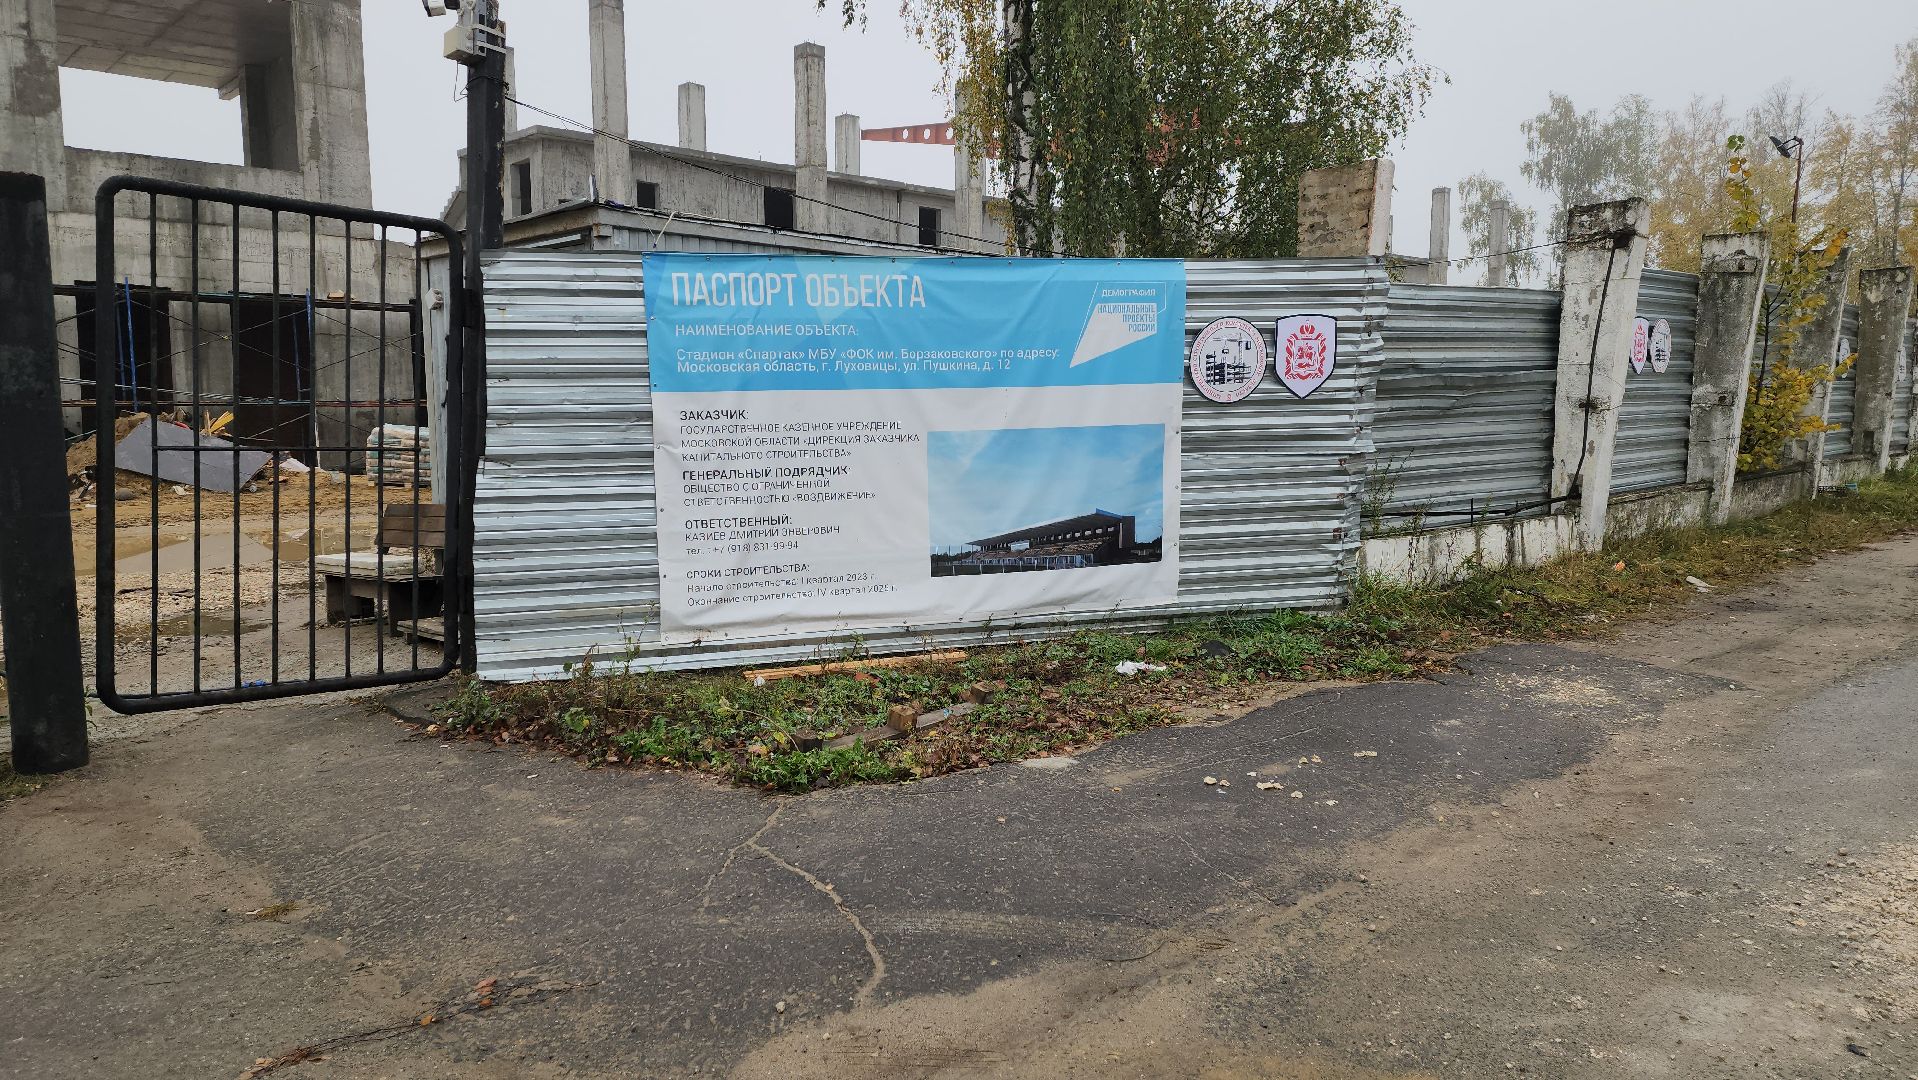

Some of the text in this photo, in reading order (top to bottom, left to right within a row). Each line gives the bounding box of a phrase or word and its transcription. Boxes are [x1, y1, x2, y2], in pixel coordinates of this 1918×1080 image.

[671, 272, 926, 308] ПАСПОРТ ОБЪЕКТА
[1101, 288, 1156, 298] ДЕМОГРАФИЯ
[1097, 303, 1156, 315] НАЦИОНАЛЬНЫЕ
[1122, 314, 1156, 323] ПРОЕКТЫ
[675, 324, 859, 337] НАИМЕНОВАНИЕ ОБЪЕКТА:
[1128, 323, 1156, 333] РОССИИ
[677, 348, 1060, 362] Стадион «Спартак» МБУ «ФОК им. Борзаковского» по адресу:
[677, 360, 1010, 374] Московская область, г. Луховицы, ул. Пушкина, д. 12
[680, 409, 749, 421] ЗАКАЗЧИК:
[680, 421, 902, 435] ГОСУДАРСТВЕННОЕ КАЗЕННОЕ УЧРЕЖДЕНИЕ
[681, 436, 752, 448] МОСКОВСКОЙ
[754, 436, 800, 447] ОБЛАСТИ
[863, 433, 920, 444] ЗАКАЗЧИКА
[682, 448, 851, 462] КАПИТАЛЬНОГО СТРОИТЕЛЬСТВА»
[682, 466, 851, 481] ГЕНЕРАЛЬНЫЙ ПОДРЯДЧИК:
[683, 478, 830, 494] ОБЩЕСТВО С ОГРАНИЧЕННОЙ
[685, 513, 793, 530] ОТВЕТСТВЕННЫЙ:
[685, 526, 840, 542] КАЗИЕВ ДМИТРИЙ ЭНВЕРОВИЧ
[686, 563, 810, 579] СРОКИ СТРОИТЕЛЬСТВА:
[687, 584, 724, 593] Начало
[806, 575, 844, 585] квартал
[847, 572, 868, 582] 2023
[687, 595, 740, 607] Окончание
[817, 588, 827, 597] IV
[830, 587, 867, 597] квартал
